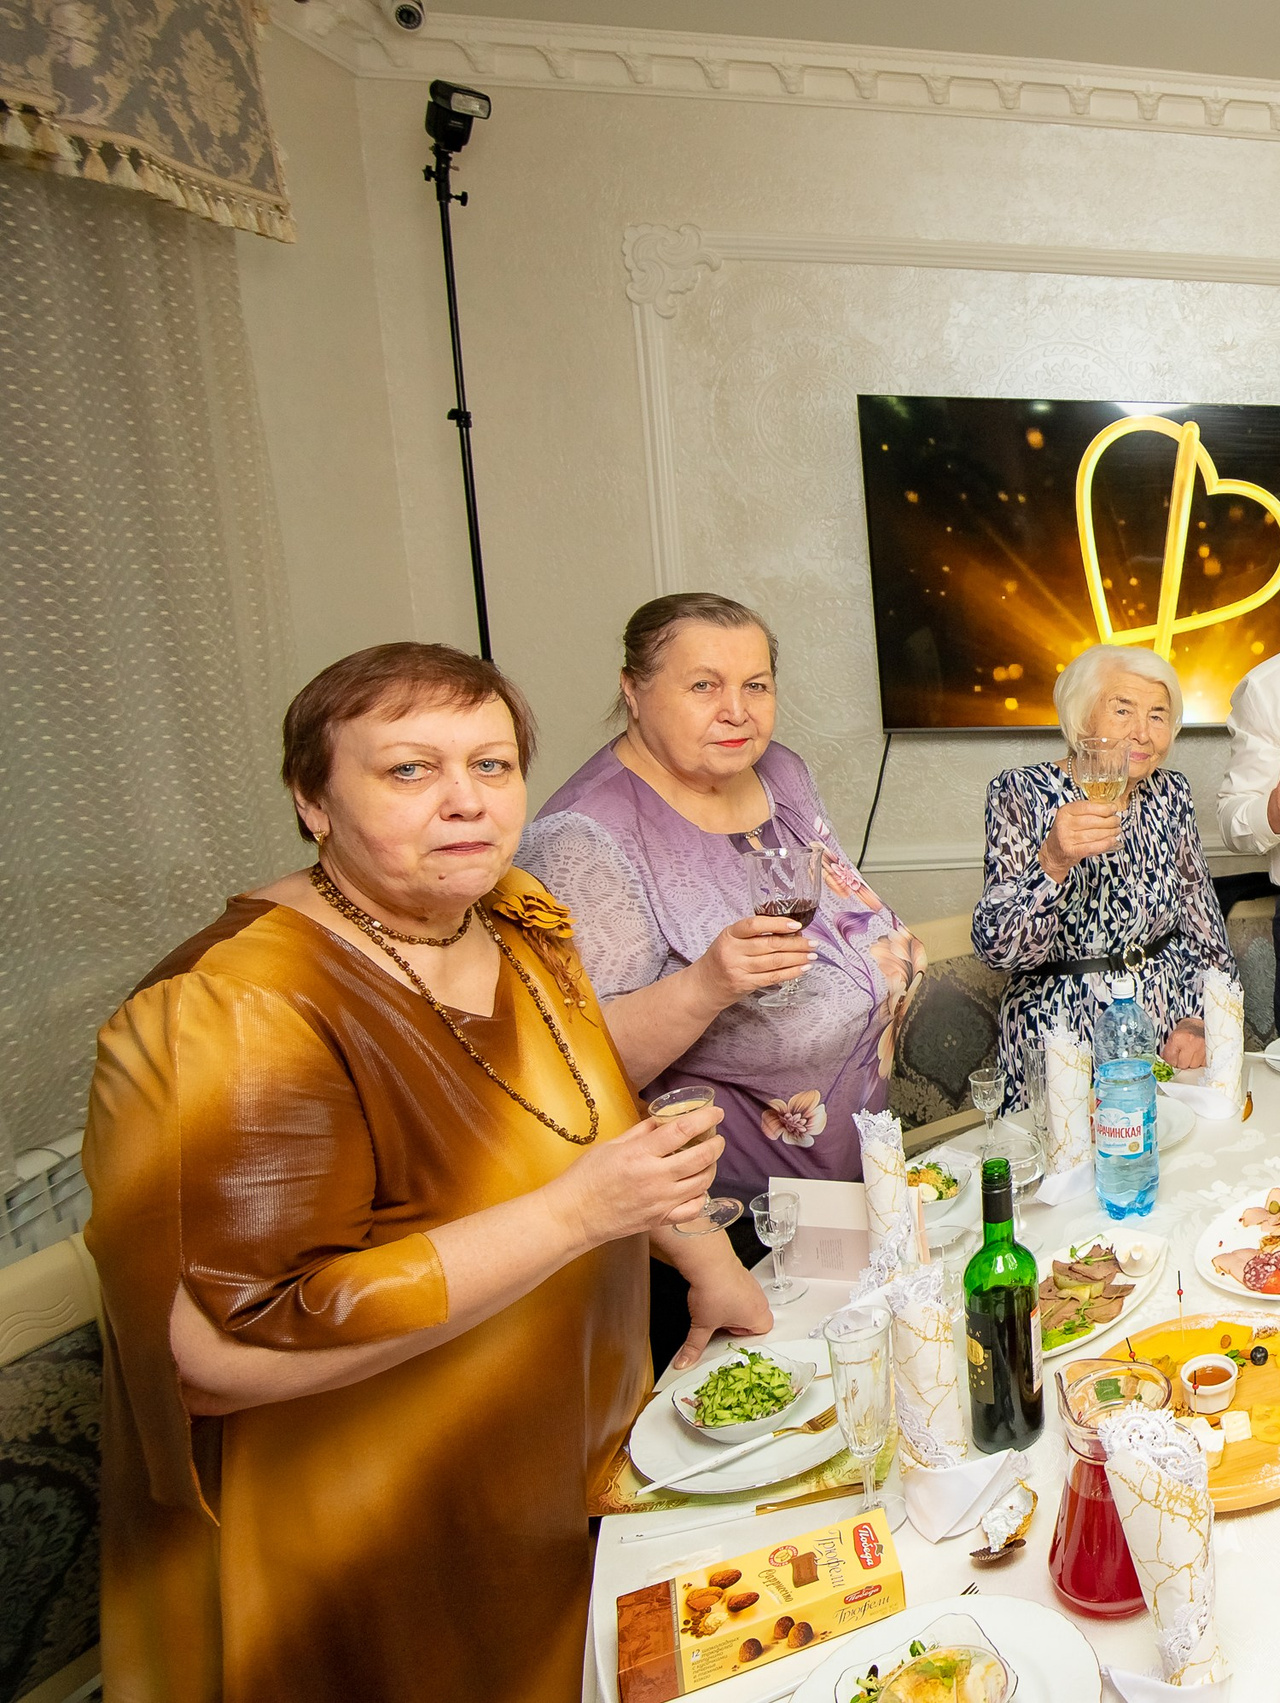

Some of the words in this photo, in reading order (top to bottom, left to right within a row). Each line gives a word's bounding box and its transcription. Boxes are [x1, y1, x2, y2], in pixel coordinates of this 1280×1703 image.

[1096, 1124, 1142, 1139] АРАЧИНСКАЯ
[813, 1528, 847, 1588] Трюфели
[857, 1524, 876, 1567] Победа
[757, 1568, 794, 1603] Cappuccino
[833, 1595, 890, 1625] Трюфели
[691, 1648, 701, 1658] 12
